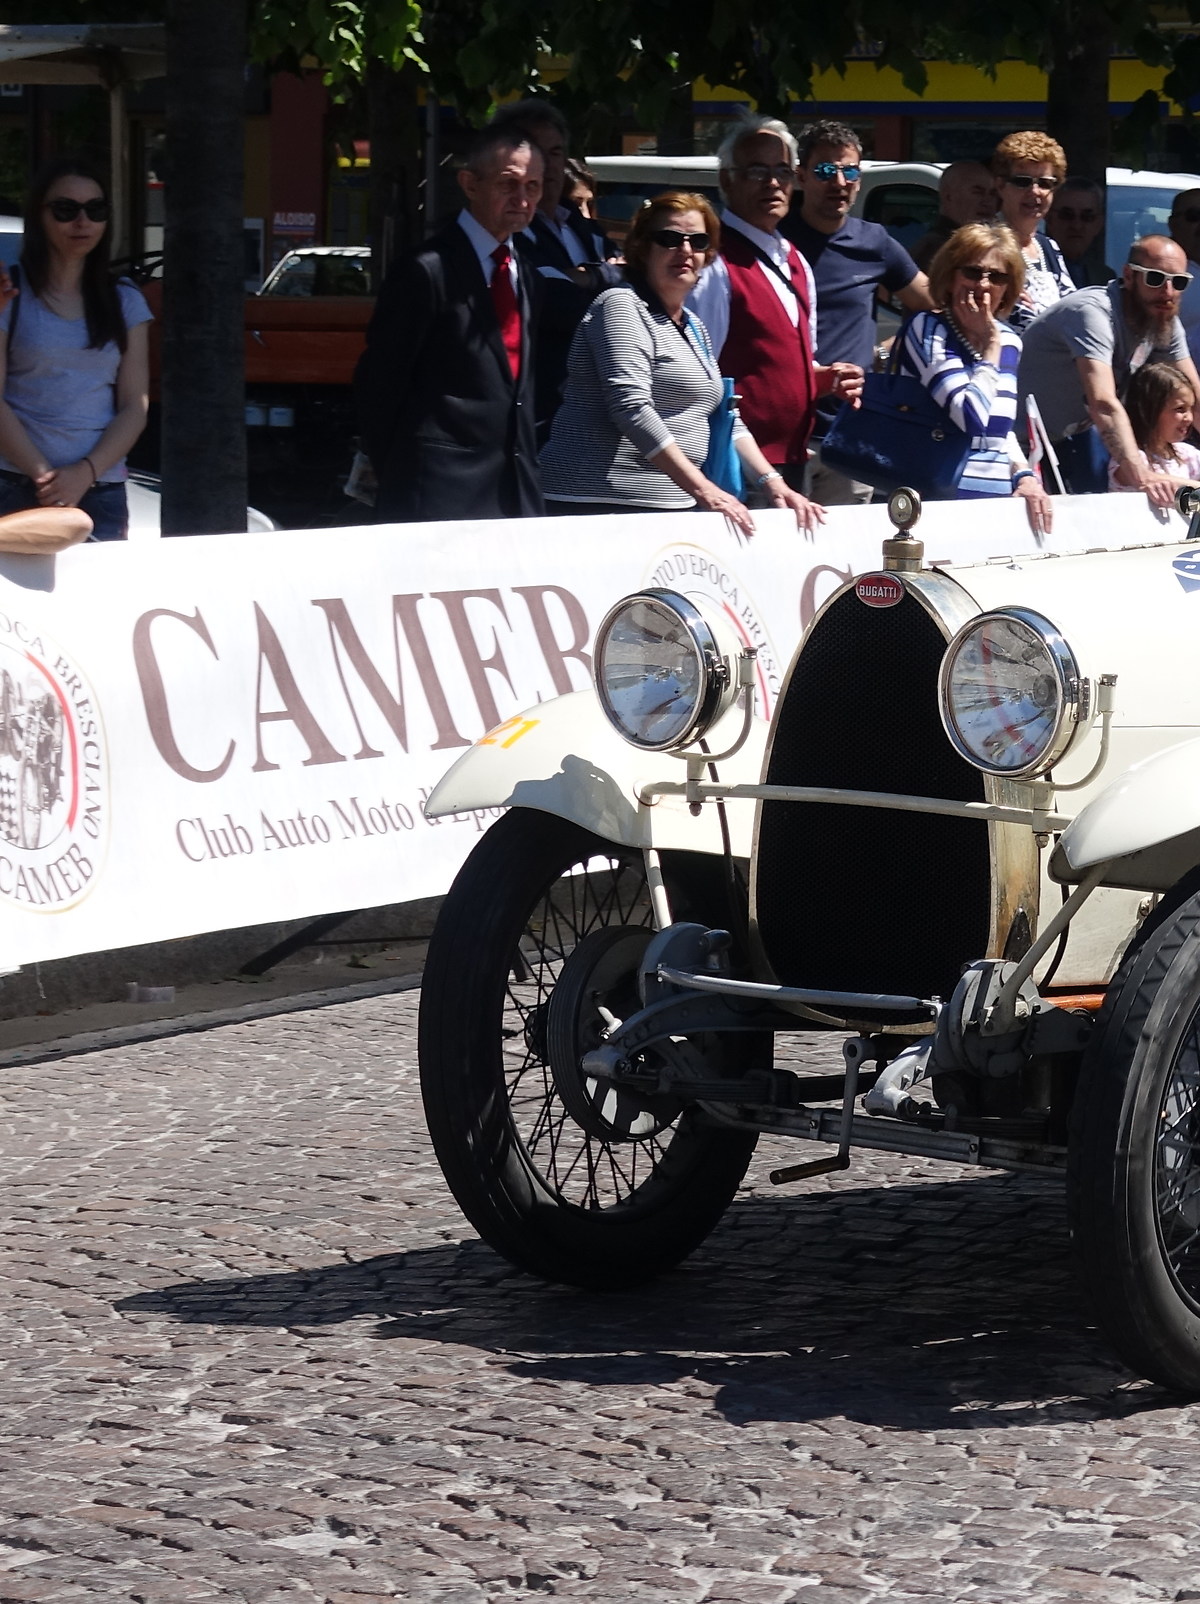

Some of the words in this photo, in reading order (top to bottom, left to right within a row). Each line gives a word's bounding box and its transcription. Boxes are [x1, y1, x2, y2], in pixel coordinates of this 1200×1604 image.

[859, 585, 897, 598] BUGATTI
[133, 584, 592, 784] CAMEB
[53, 655, 102, 840] BRESCIANO
[175, 813, 254, 862] Club
[259, 809, 332, 852] Auto
[329, 797, 415, 840] Moto
